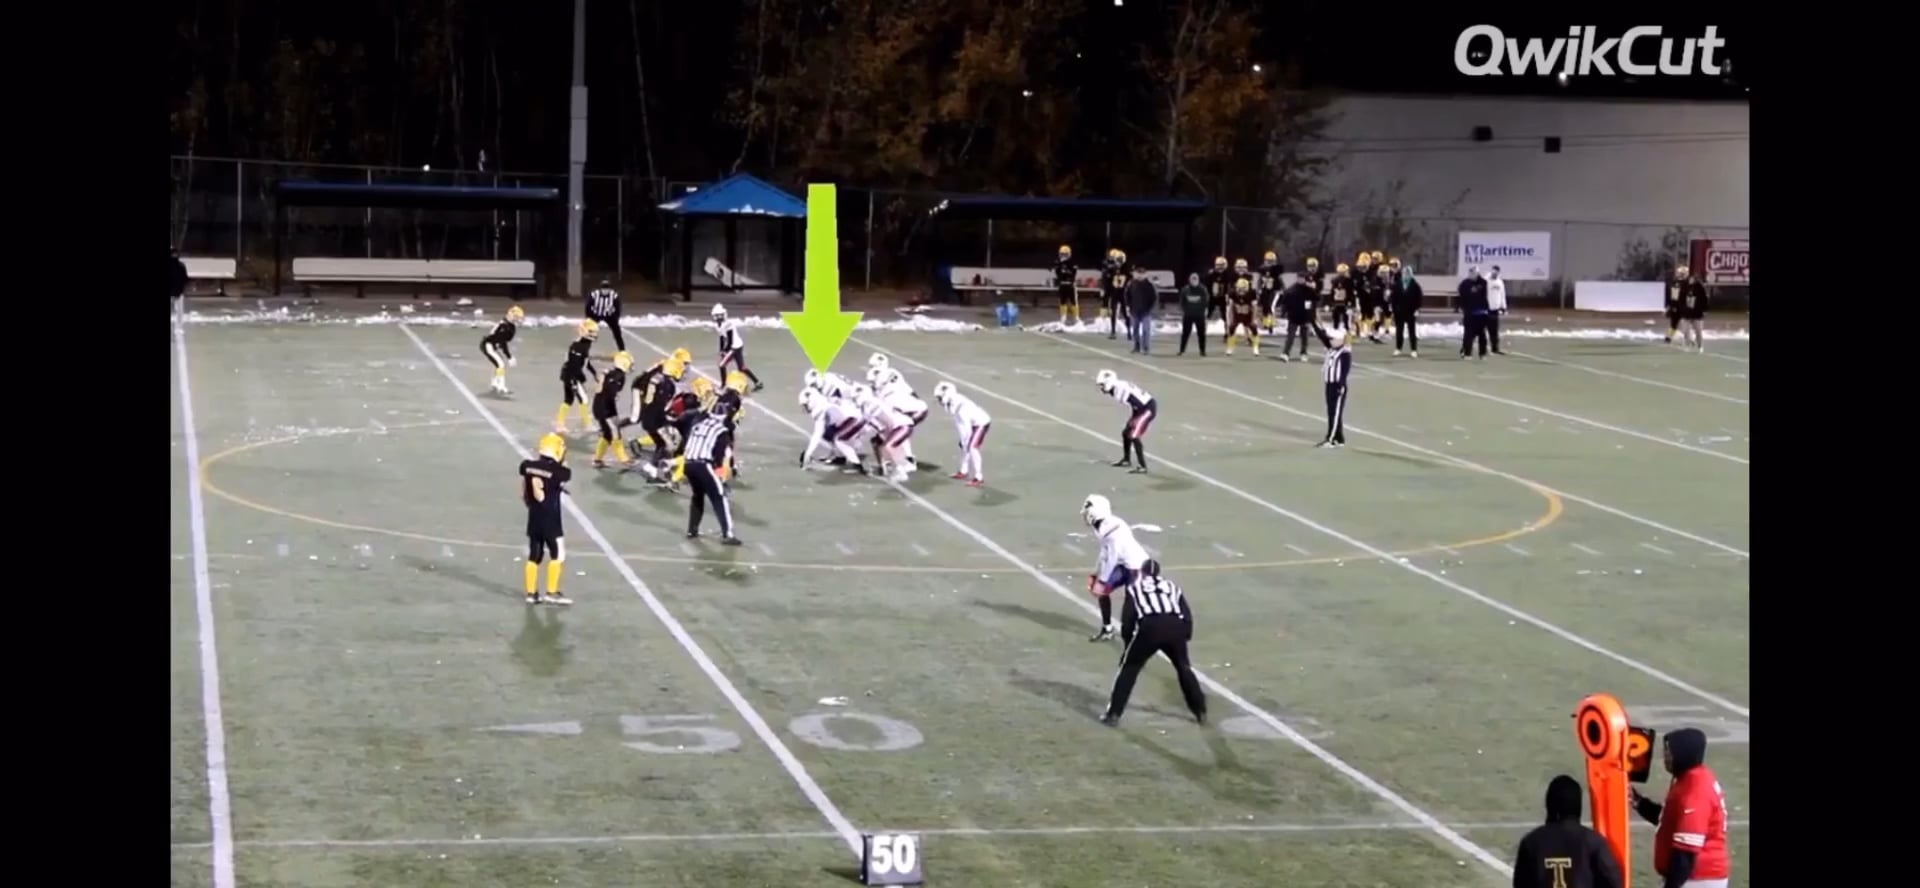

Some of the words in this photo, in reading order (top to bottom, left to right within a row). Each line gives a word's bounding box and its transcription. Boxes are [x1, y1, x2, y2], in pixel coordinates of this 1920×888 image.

[619, 712, 924, 754] 50
[871, 834, 916, 874] 50
[1544, 857, 1572, 888] T
